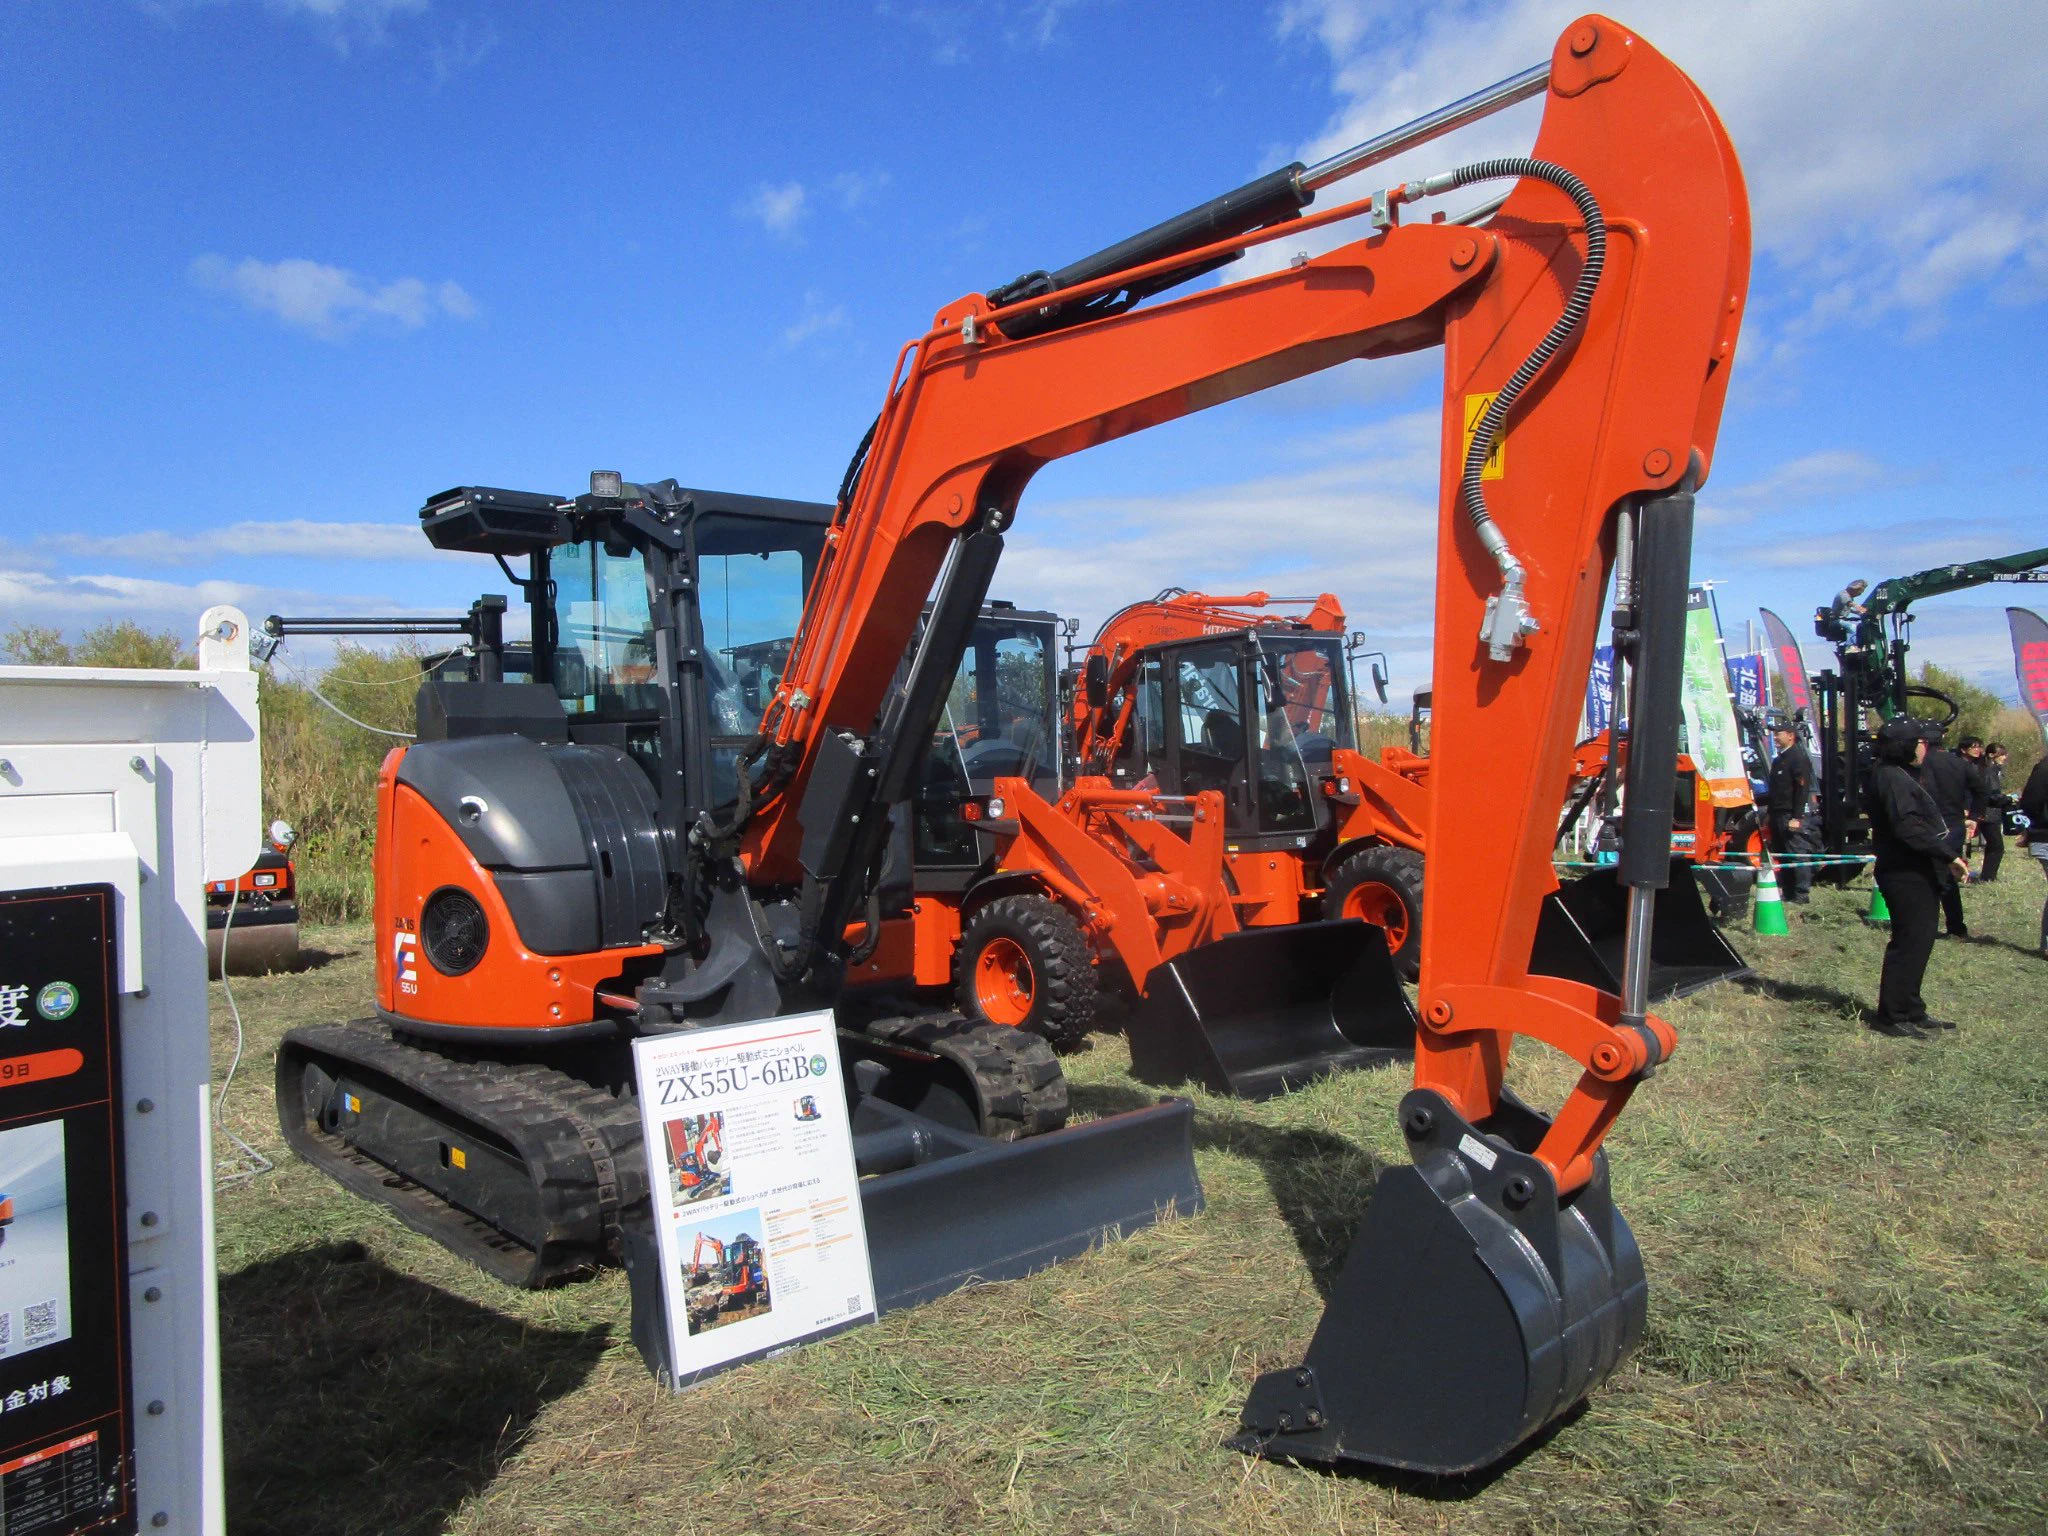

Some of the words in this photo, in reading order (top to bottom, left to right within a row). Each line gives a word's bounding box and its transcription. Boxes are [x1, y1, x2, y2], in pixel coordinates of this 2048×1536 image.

[401, 981, 418, 995] 55U
[658, 1055, 810, 1105] ZX55U-6EB
[0, 1375, 72, 1414] 金対象
